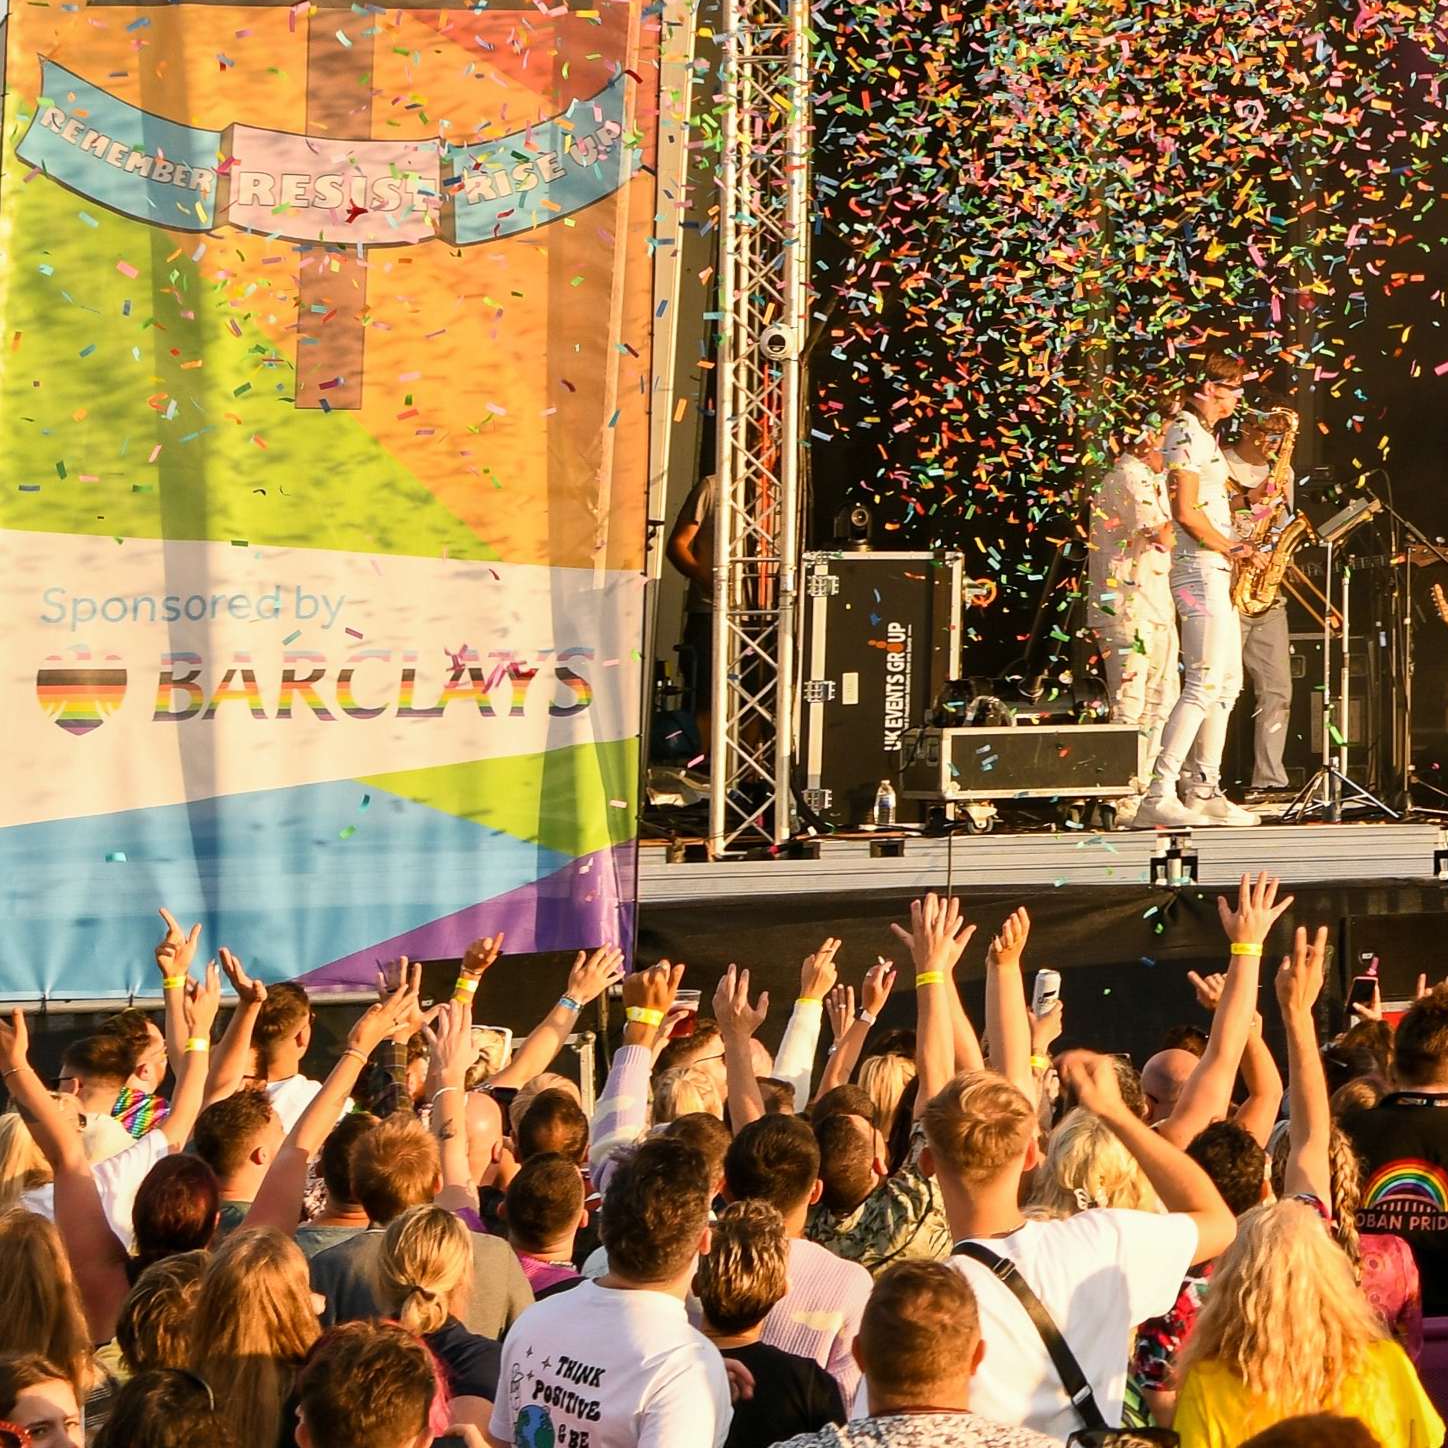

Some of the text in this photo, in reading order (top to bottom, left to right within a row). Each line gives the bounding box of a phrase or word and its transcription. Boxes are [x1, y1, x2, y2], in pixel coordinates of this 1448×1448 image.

[40, 105, 621, 212] REMEMBER RESIST RISE UP
[40, 585, 346, 632] Sponsored by
[152, 647, 595, 722] BARCLAYS
[884, 621, 907, 751] UK EVENTS GROUP
[1355, 1213, 1403, 1230] OBAN
[555, 1355, 606, 1387] THINK
[532, 1379, 602, 1422] POSITIVE
[568, 1429, 590, 1448] BE
